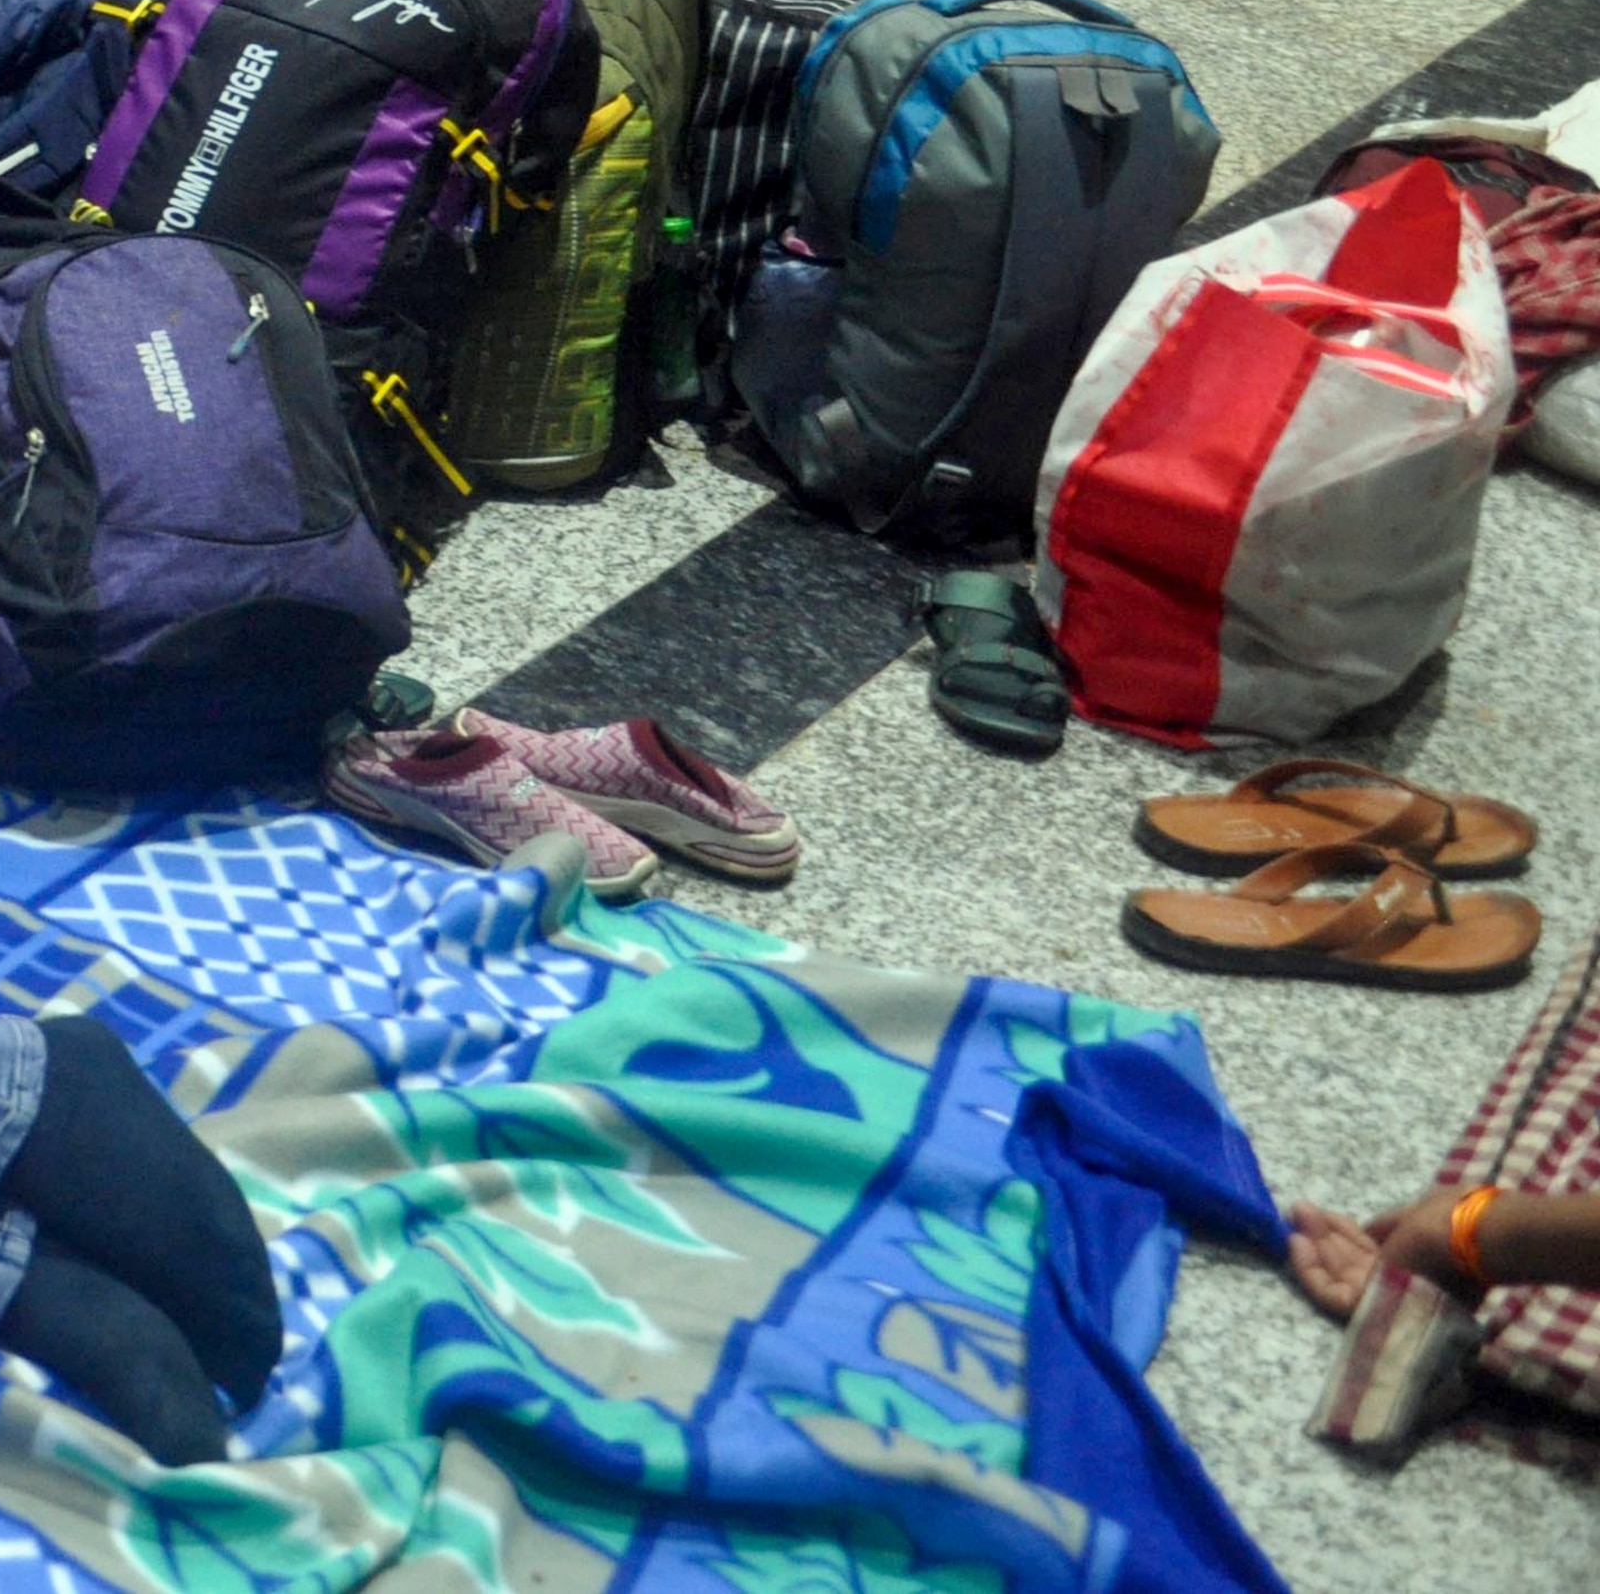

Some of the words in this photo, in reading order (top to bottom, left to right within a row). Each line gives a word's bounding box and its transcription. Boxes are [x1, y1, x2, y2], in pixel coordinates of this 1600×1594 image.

[155, 156, 219, 234] TOMMY
[202, 43, 279, 144] HILFIGER
[135, 342, 175, 413] AFRICAN
[150, 329, 196, 424] TOURISTER
